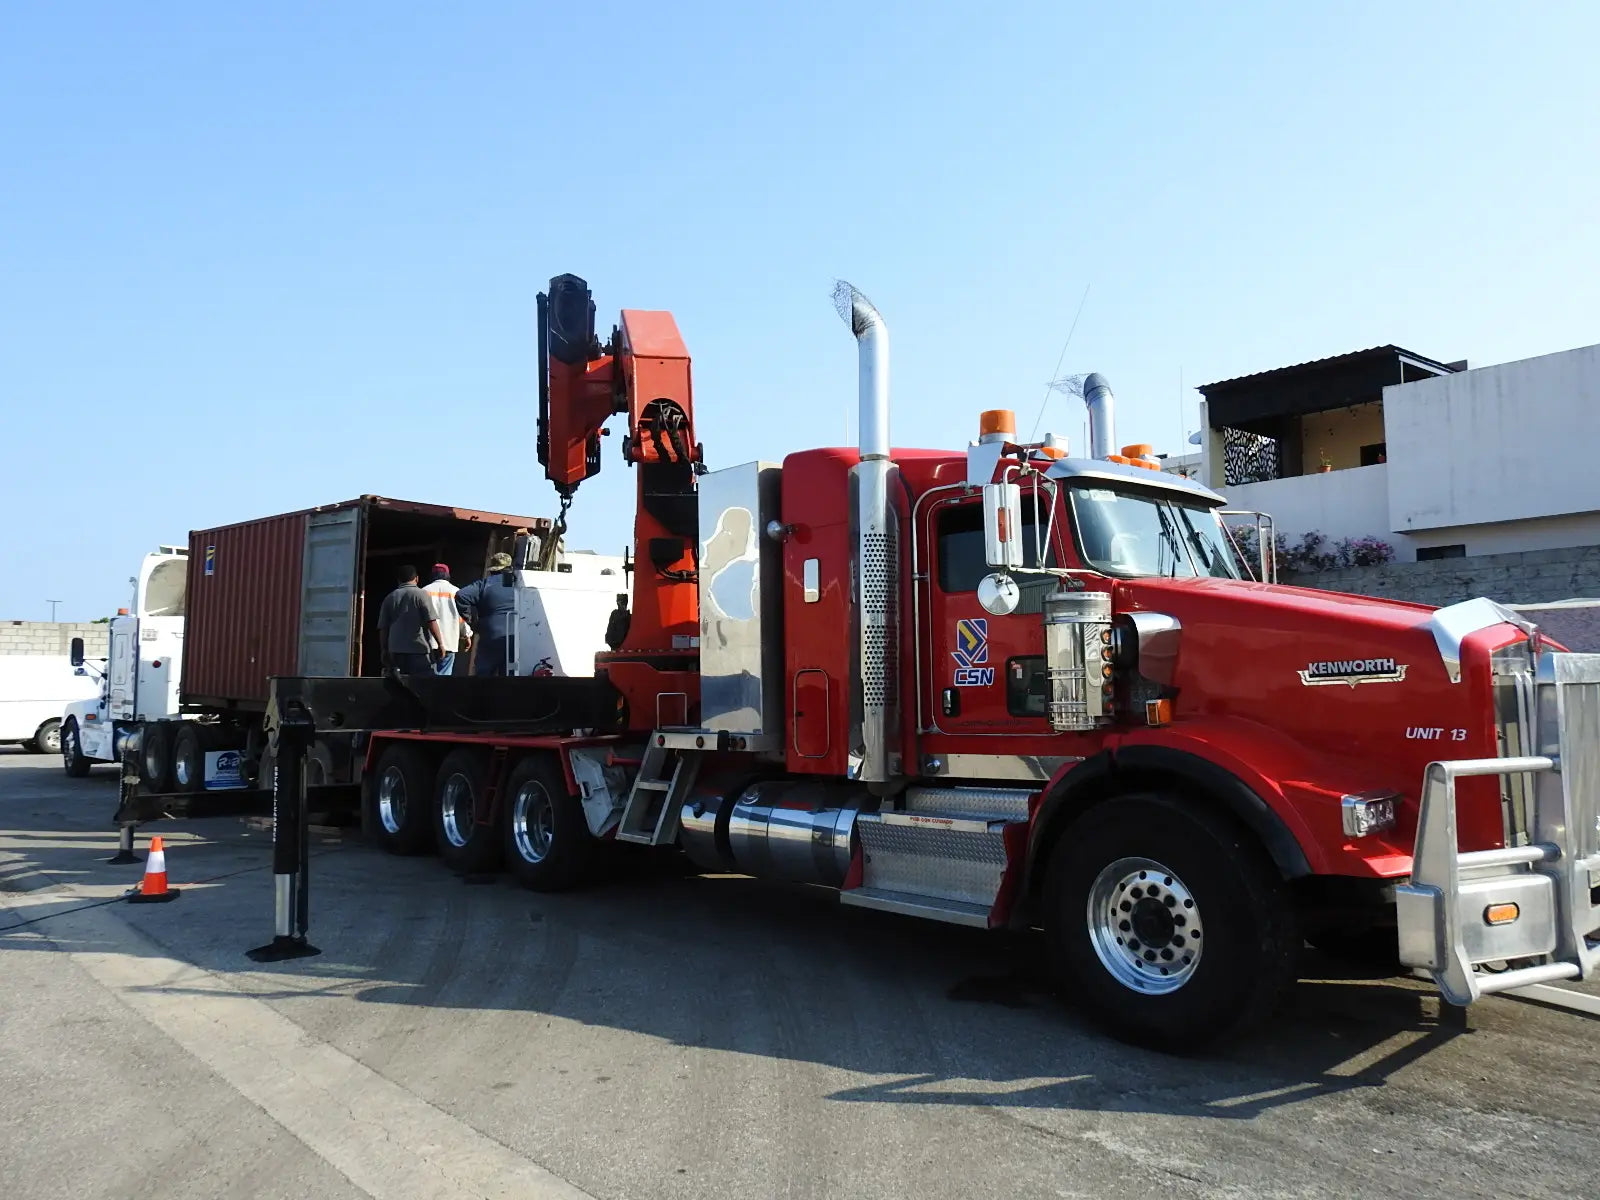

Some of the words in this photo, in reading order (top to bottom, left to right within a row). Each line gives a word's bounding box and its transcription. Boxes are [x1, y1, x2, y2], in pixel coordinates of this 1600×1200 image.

[1308, 658, 1395, 675] KENWORTH
[954, 668, 994, 686] CSN
[1405, 726, 1444, 740] UNIT
[1450, 728, 1467, 741] 13
